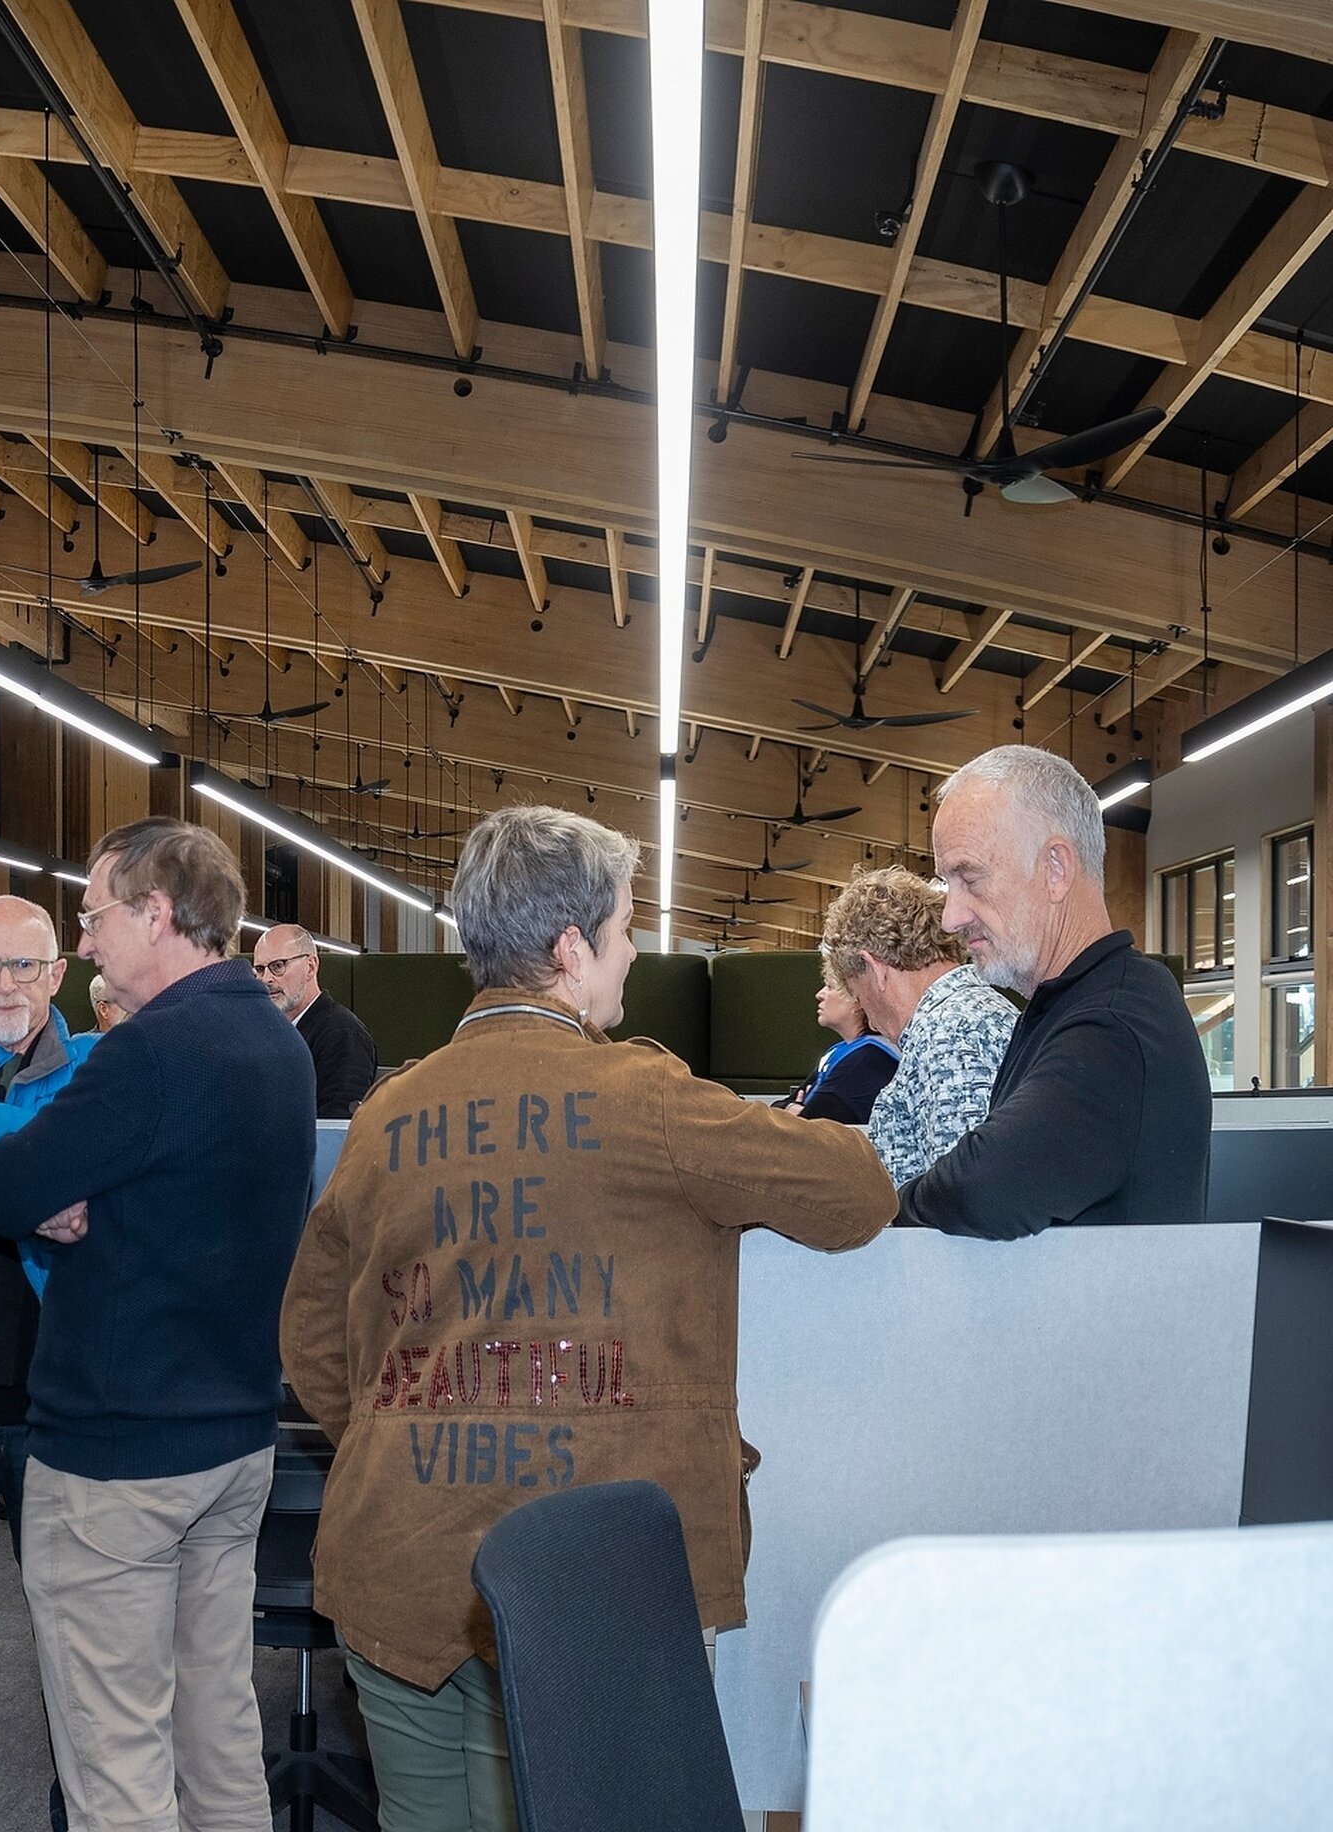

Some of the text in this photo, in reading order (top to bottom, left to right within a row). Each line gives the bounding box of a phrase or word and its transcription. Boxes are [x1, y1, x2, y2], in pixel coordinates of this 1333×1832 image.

[384, 1091, 602, 1172] THERE
[435, 1176, 546, 1248] ARE
[382, 1253, 615, 1326] SO MANY
[373, 1340, 634, 1411] BEAUTIFUL
[409, 1422, 575, 1486] VIBES
